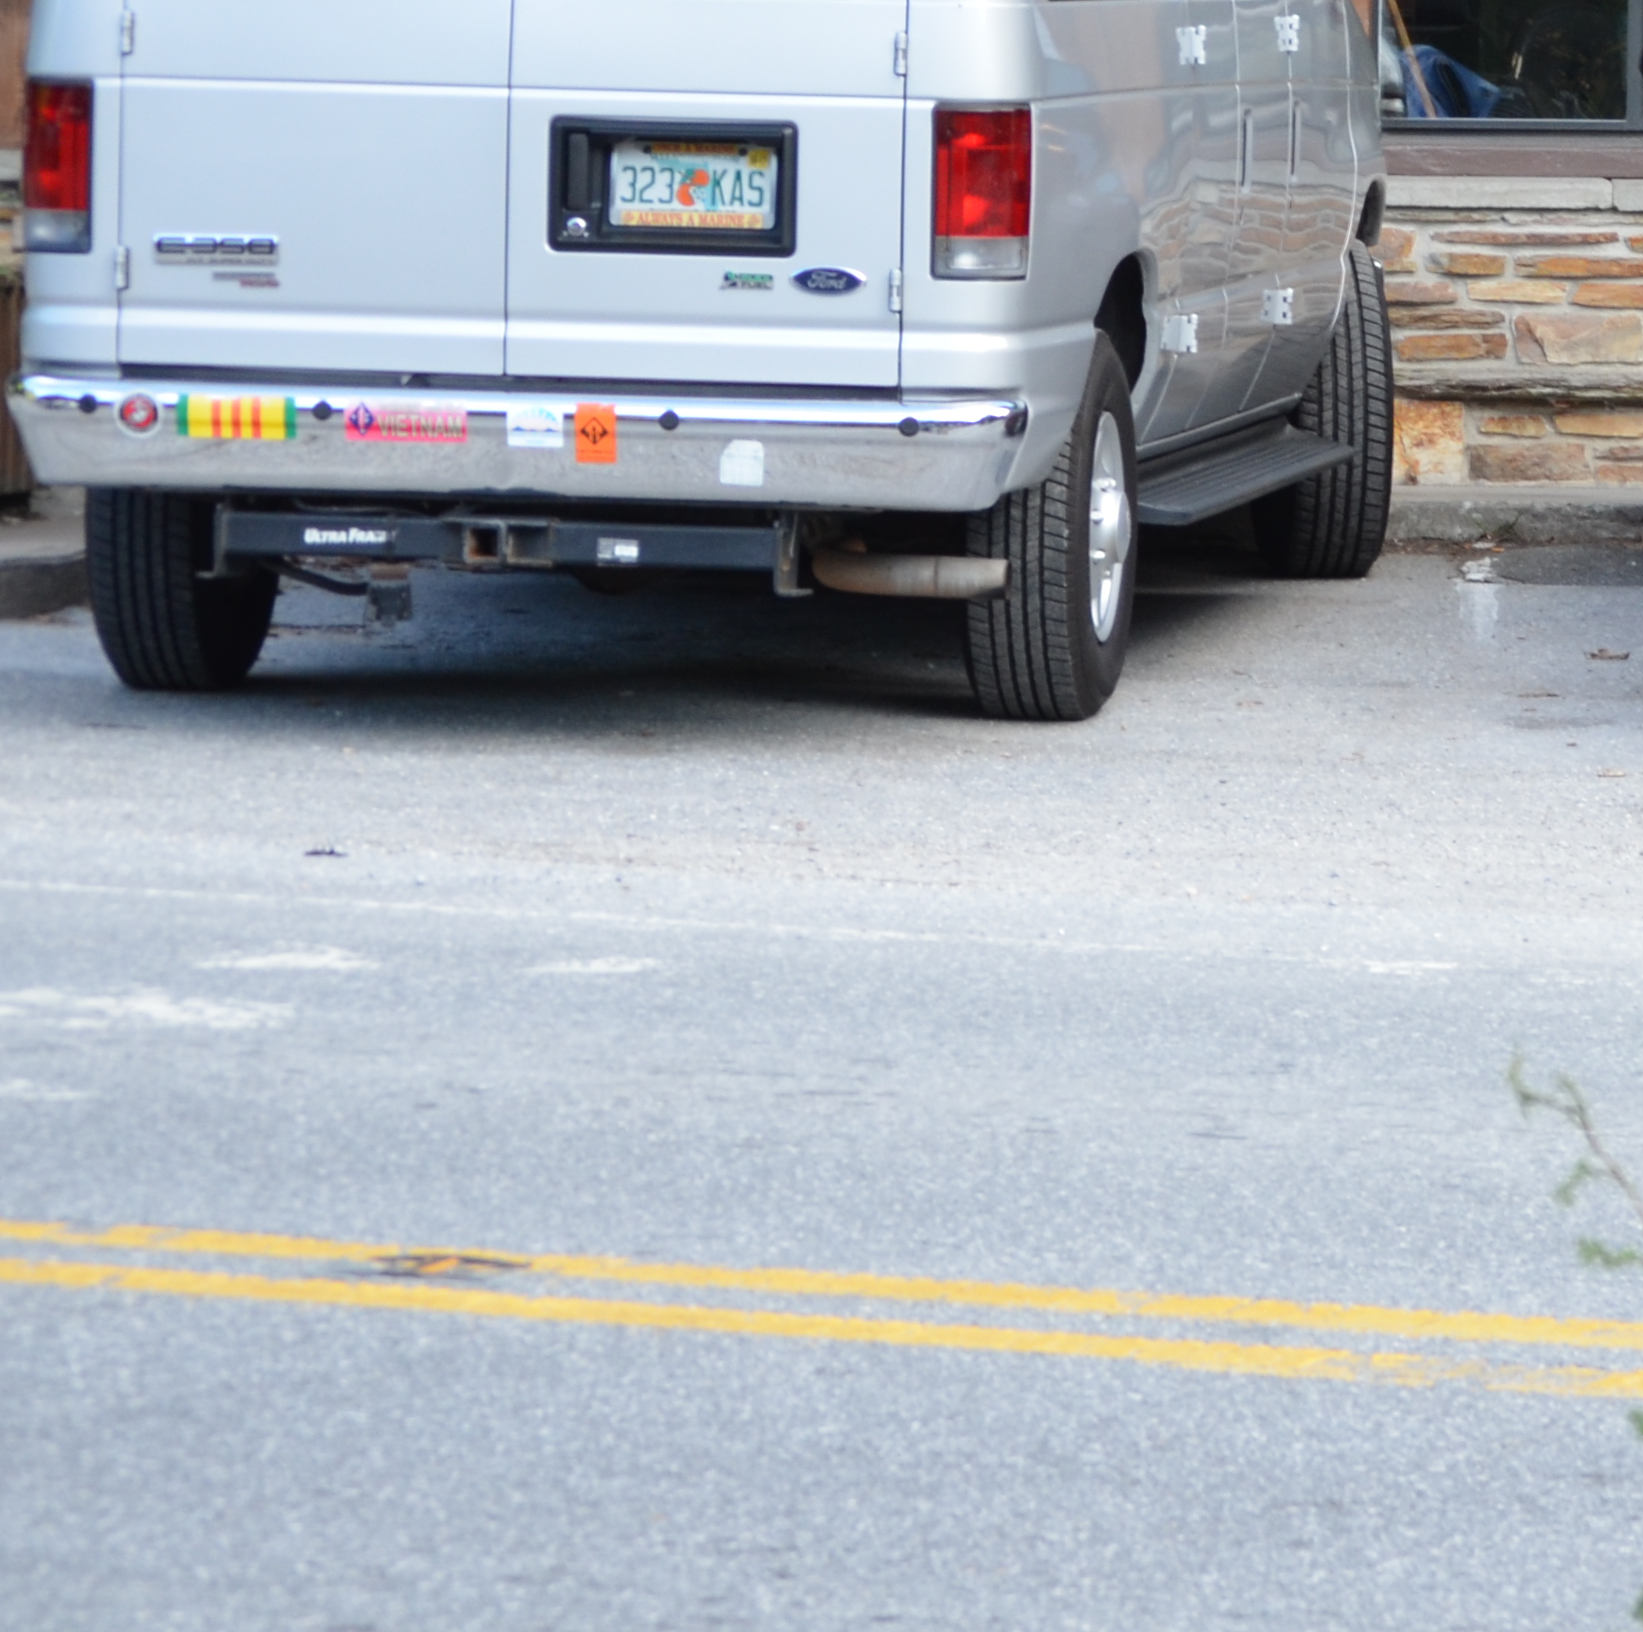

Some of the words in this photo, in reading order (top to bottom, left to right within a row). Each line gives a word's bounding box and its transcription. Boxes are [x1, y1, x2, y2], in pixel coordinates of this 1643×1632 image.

[619, 165, 675, 205] 323
[711, 167, 766, 208] KAS
[806, 270, 848, 290] Ford
[376, 414, 464, 439] VIETNAM
